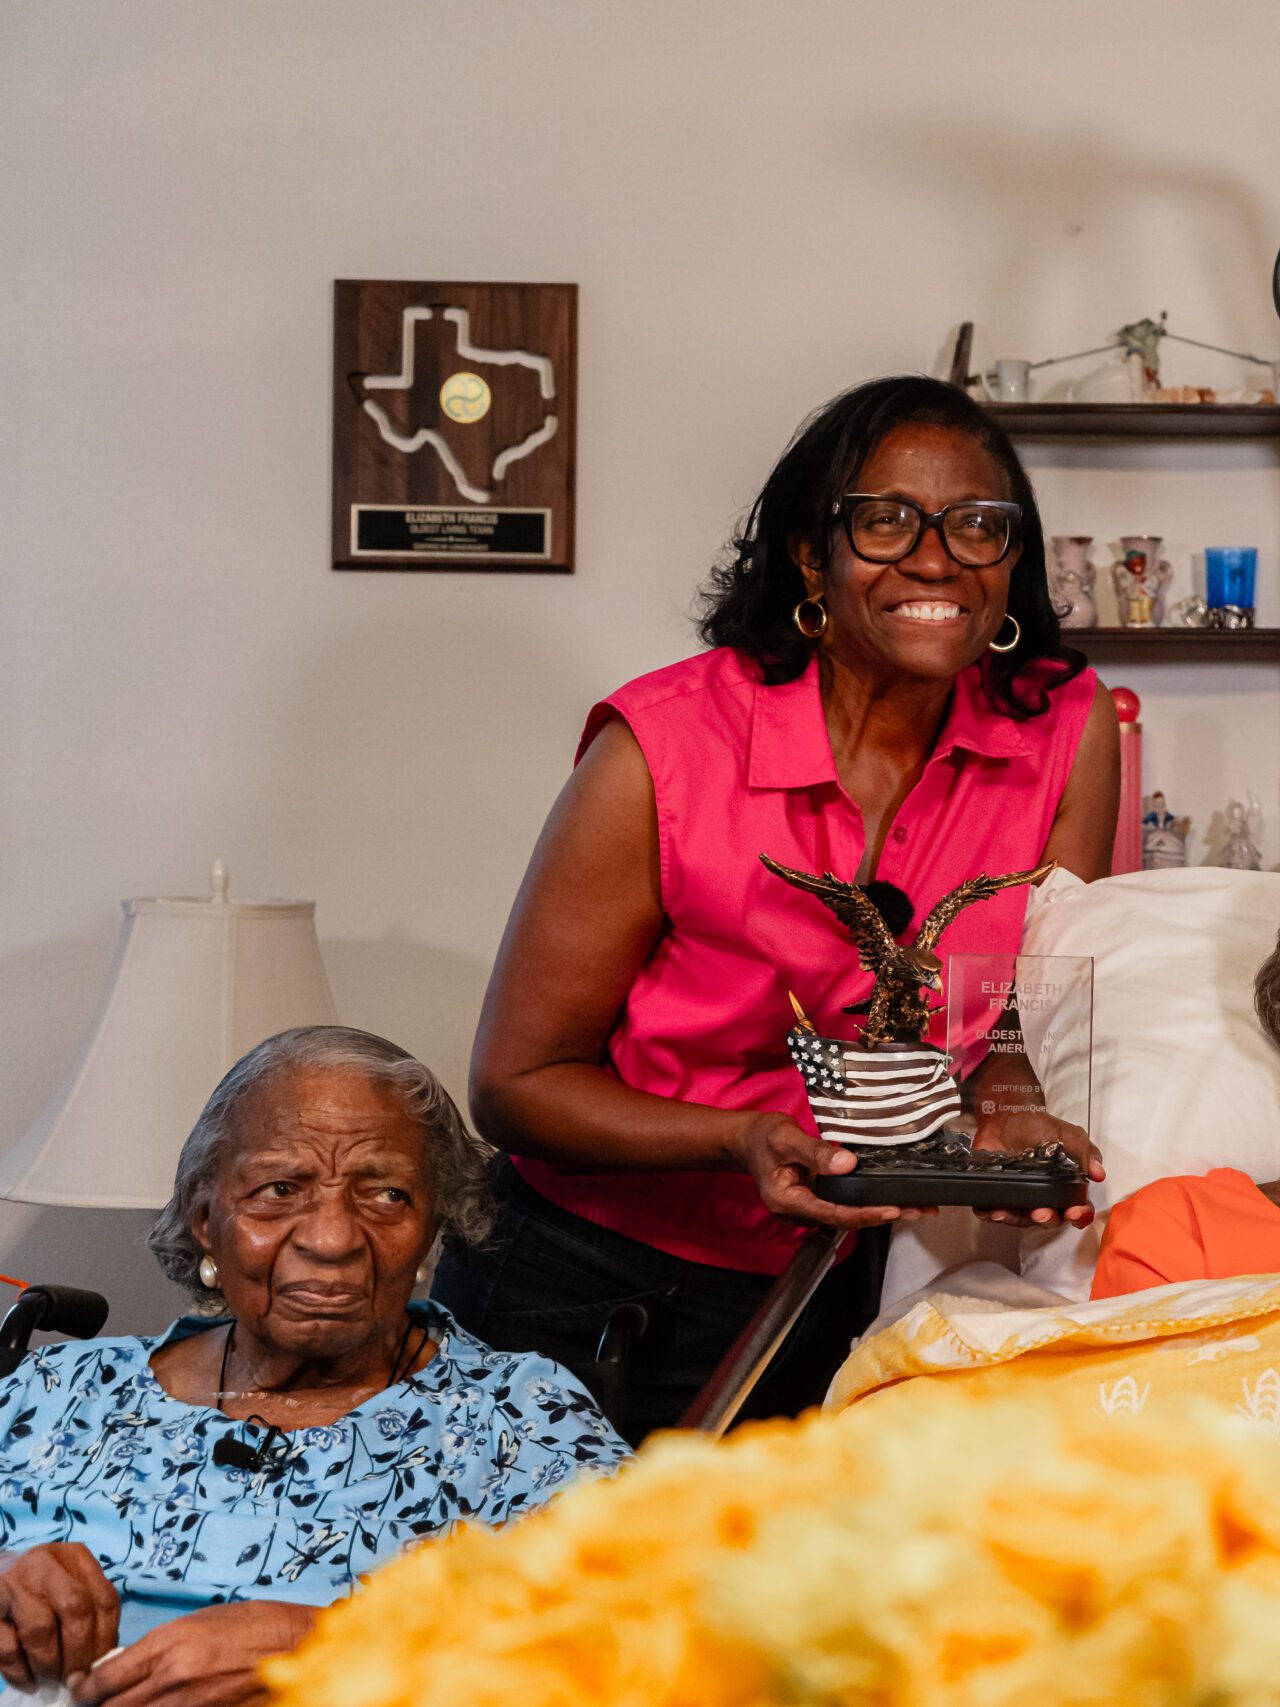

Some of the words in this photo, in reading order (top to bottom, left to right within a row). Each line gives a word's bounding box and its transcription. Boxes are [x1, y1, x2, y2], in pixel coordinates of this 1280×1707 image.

[981, 981, 1062, 995] ELIZABETH
[989, 998, 1053, 1011] FRANCIS
[975, 1029, 1023, 1040] OLDEST
[991, 1084, 1033, 1093] CERTIFIED
